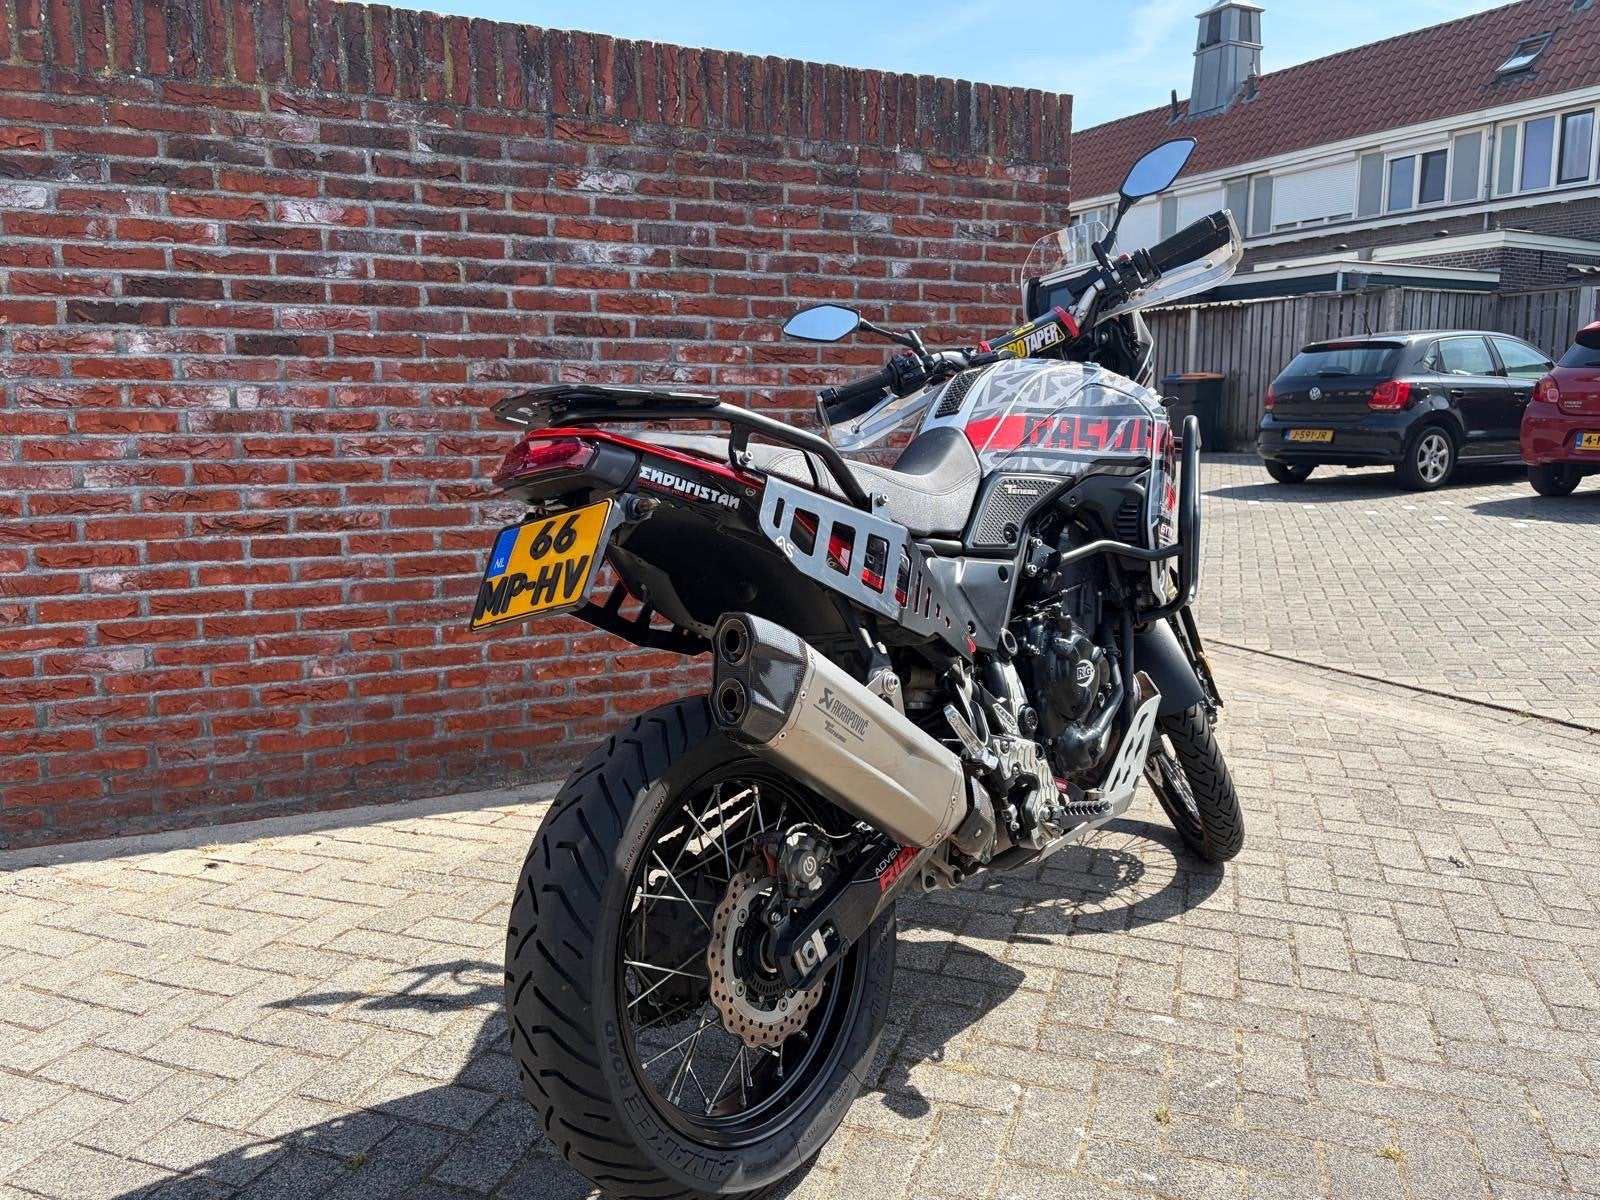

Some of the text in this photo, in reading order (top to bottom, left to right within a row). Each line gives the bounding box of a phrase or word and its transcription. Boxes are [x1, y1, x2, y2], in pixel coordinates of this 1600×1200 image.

[529, 514, 581, 561] 66
[493, 557, 505, 570] NL
[474, 555, 590, 621] MP-HV
